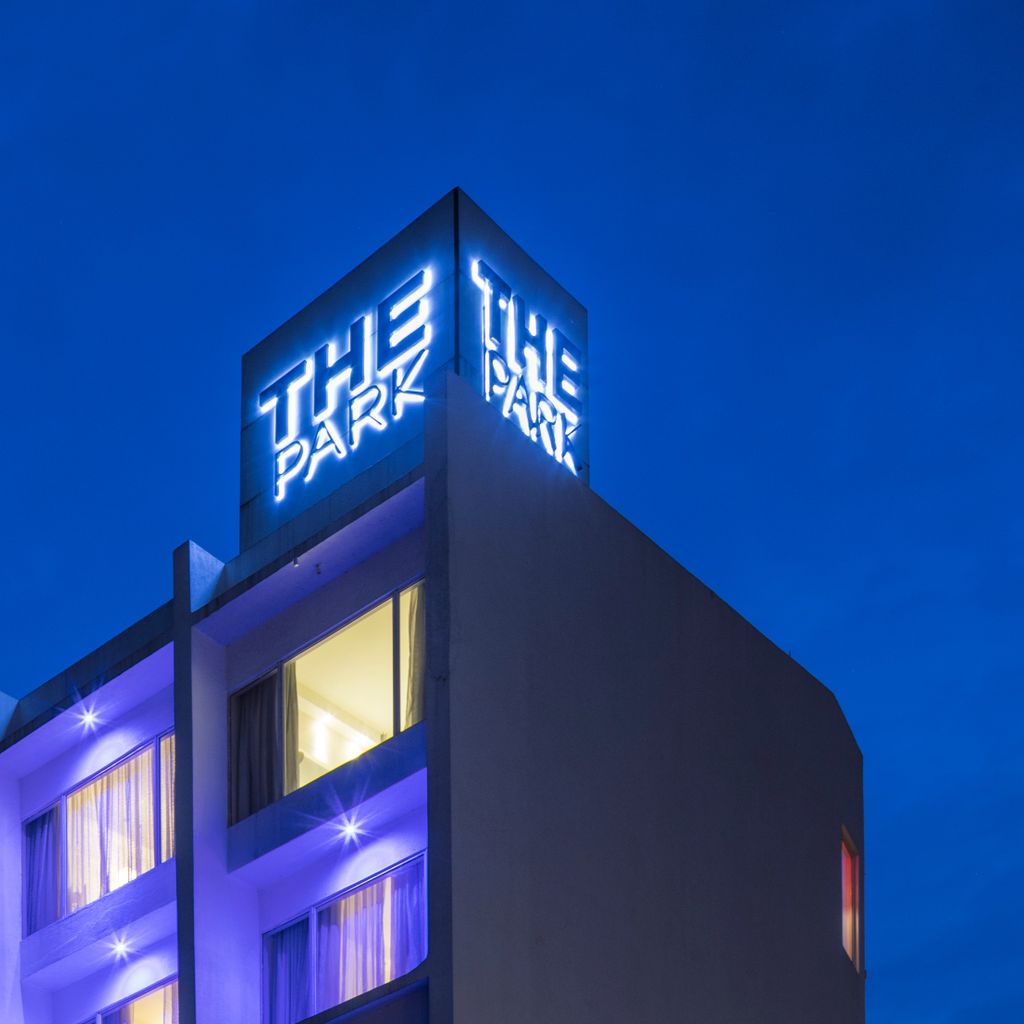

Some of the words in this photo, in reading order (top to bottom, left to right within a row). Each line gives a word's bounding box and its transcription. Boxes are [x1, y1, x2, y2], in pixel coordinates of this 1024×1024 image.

[258, 267, 432, 447] THE
[473, 258, 583, 424] THE
[483, 349, 581, 477] PARK
[274, 348, 429, 502] PARK
